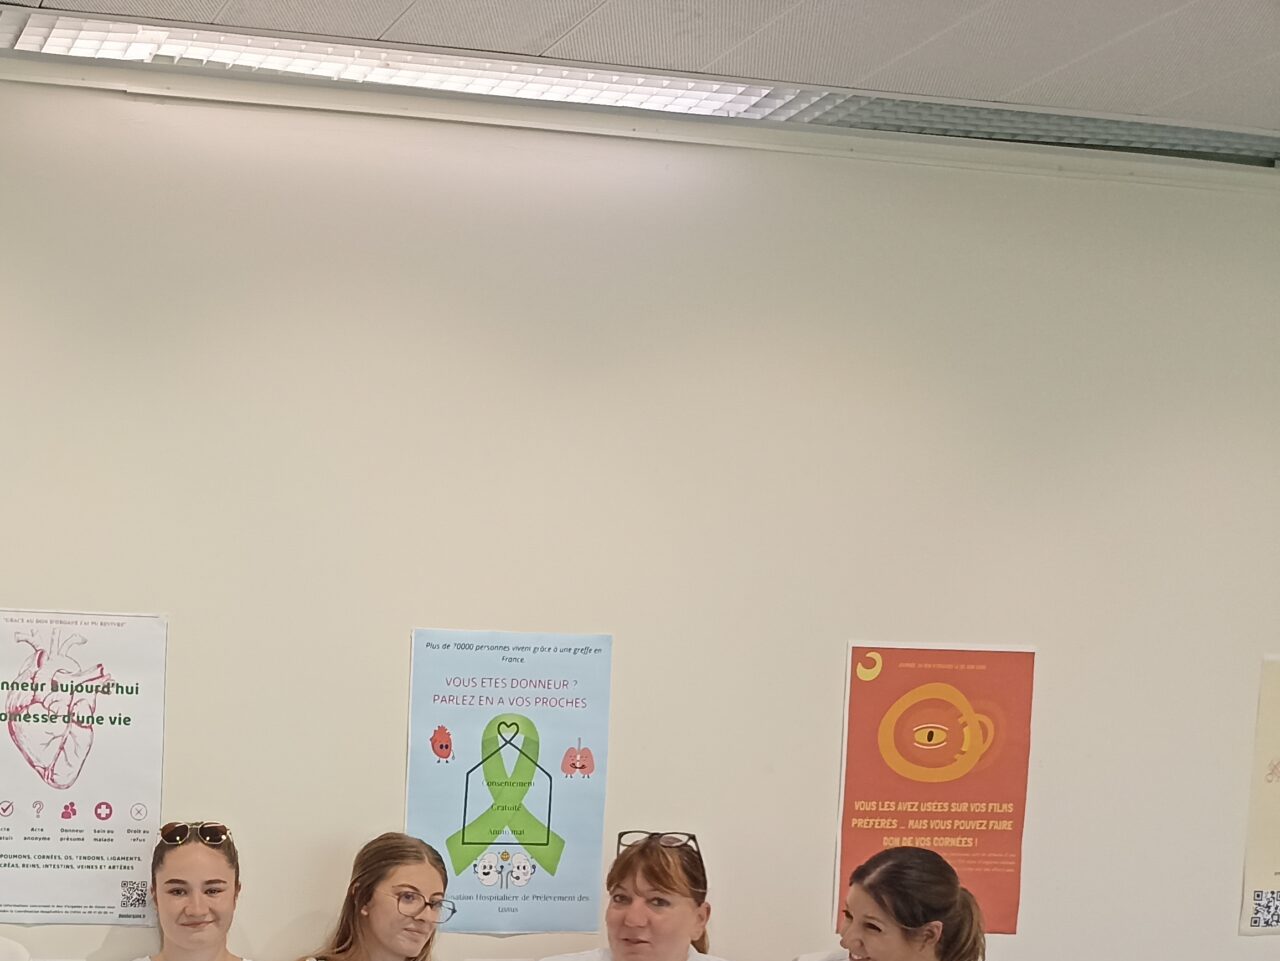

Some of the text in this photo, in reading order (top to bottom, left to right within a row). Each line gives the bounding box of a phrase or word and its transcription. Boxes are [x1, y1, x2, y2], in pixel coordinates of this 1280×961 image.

[426, 642, 440, 650] Plus
[442, 642, 450, 650] de
[475, 645, 510, 653] personnes
[573, 647, 592, 655] greffe
[50, 680, 139, 695] aujourd'hui
[445, 677, 578, 690] VOUS ETES DONNEUR ?
[433, 695, 587, 709] PARLEZ EN A VOS PROCHES
[109, 713, 131, 726] vie
[854, 801, 876, 811] VOUS
[878, 801, 895, 811] LES
[897, 801, 919, 812] AVEZ
[950, 802, 968, 812] SUR
[970, 802, 986, 812] VOS
[988, 803, 1013, 813] FILMS
[908, 819, 927, 830] MAIS
[930, 820, 952, 830] VOUS
[954, 820, 987, 830] POUVEZ
[988, 820, 1013, 830] FAIRE
[883, 836, 900, 846] DON
[902, 836, 913, 846] DE
[915, 837, 931, 847] VOS
